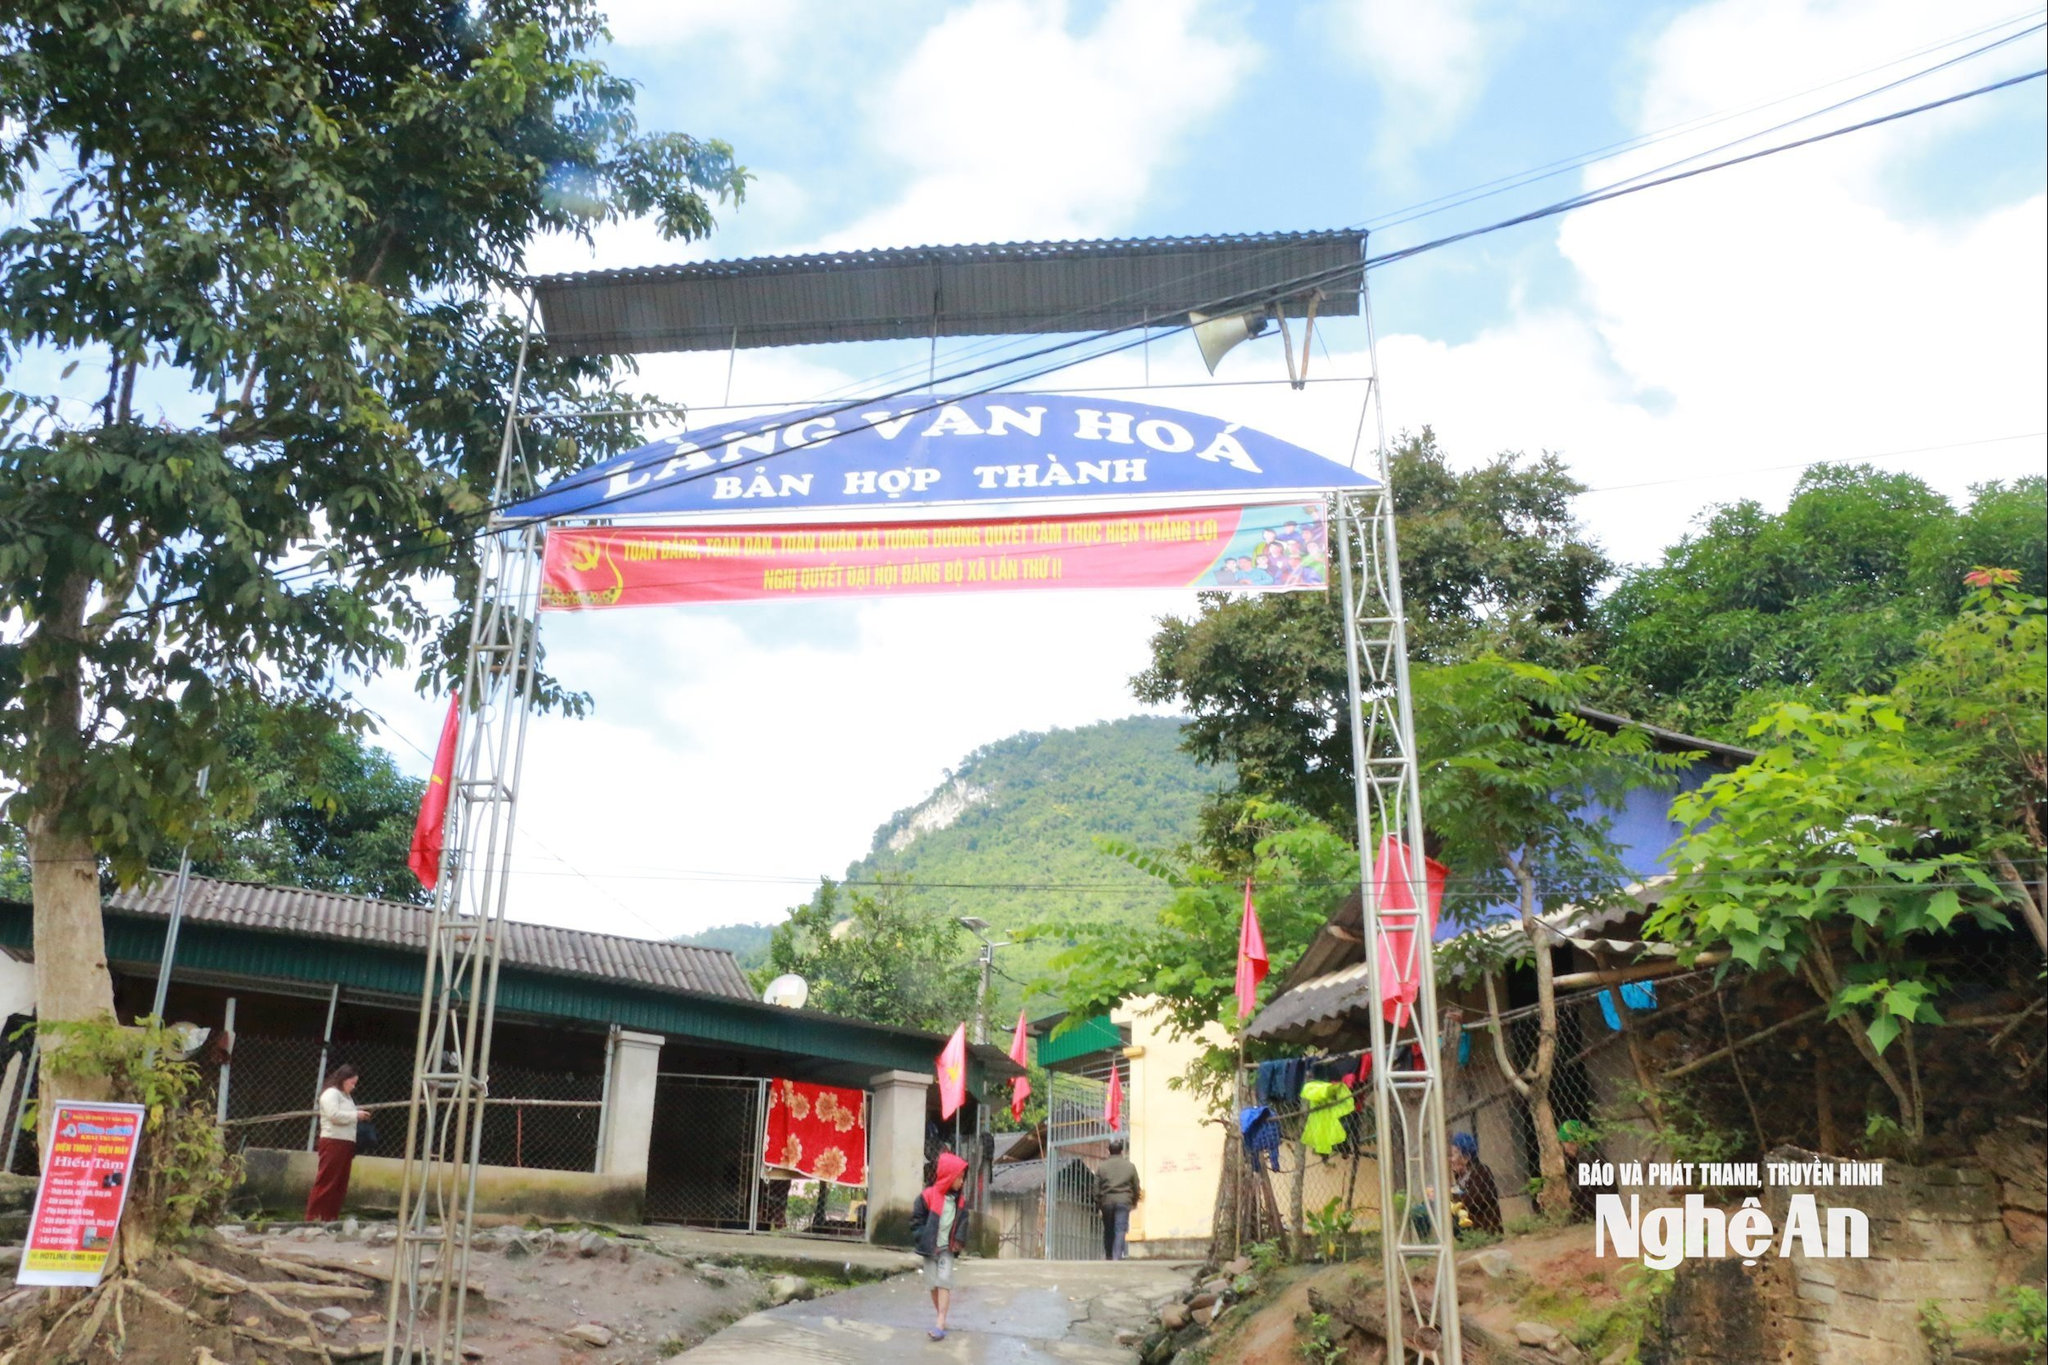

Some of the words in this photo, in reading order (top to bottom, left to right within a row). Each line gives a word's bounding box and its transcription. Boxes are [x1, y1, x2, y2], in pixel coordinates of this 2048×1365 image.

[603, 416, 841, 499] LÀNG
[1074, 409, 1263, 474] HOÁ
[712, 466, 813, 499] BẢN
[843, 466, 941, 498] HỢP
[973, 453, 1147, 488] THÀNH
[764, 568, 797, 592] NGHỊ
